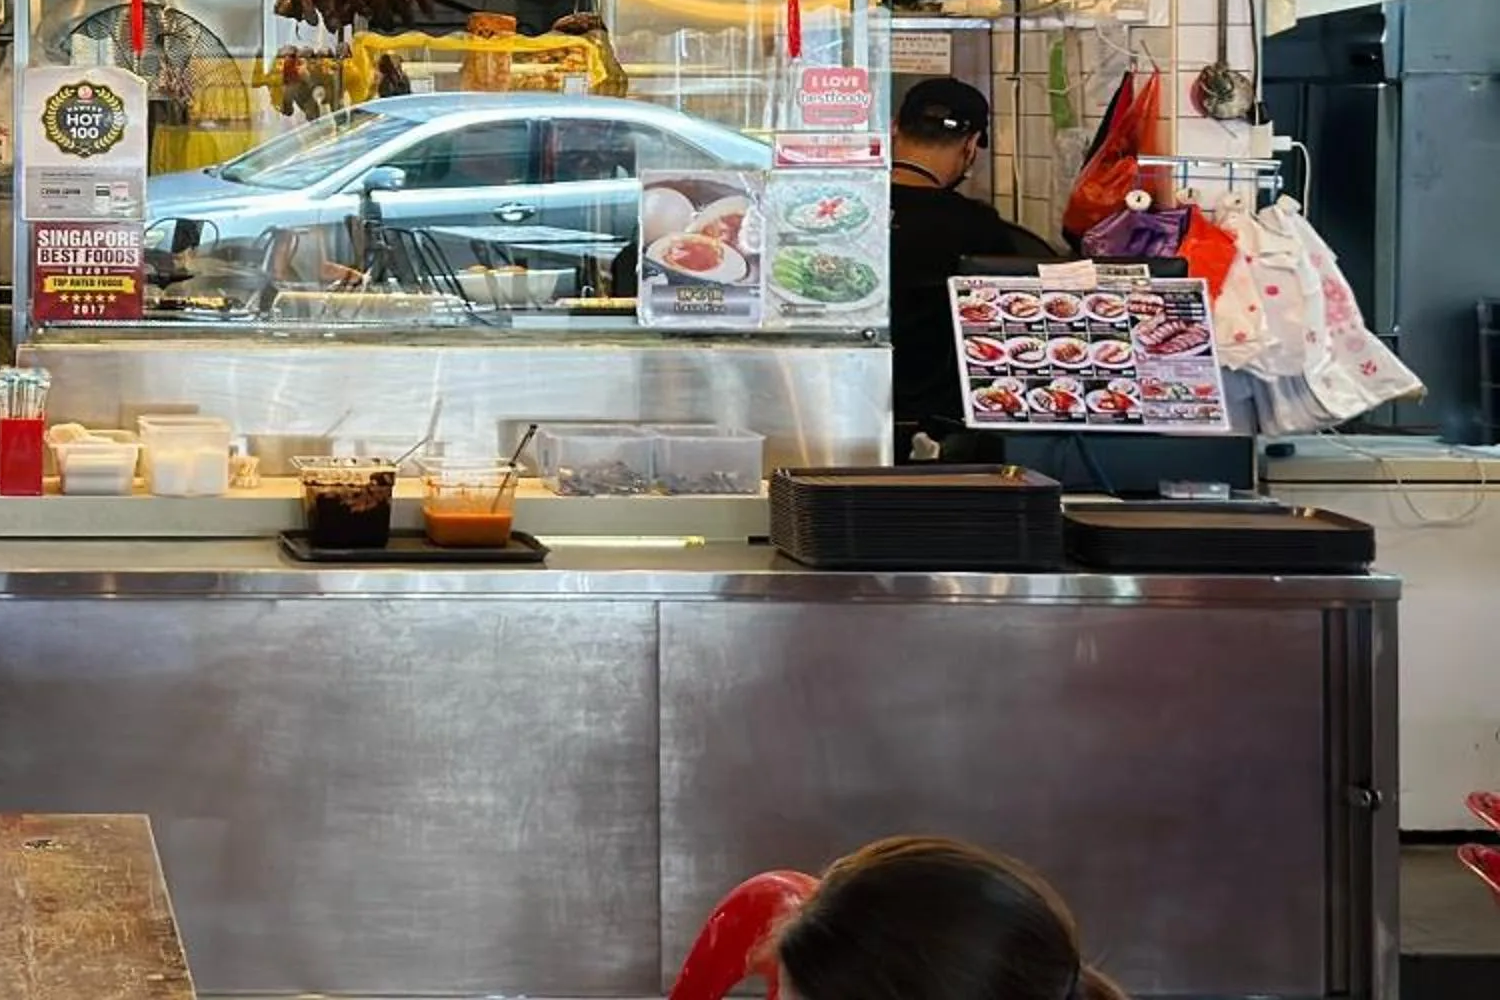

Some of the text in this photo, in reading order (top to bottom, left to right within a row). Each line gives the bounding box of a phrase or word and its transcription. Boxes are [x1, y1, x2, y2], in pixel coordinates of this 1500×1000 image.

[821, 76, 860, 87] LOVE
[66, 113, 103, 127] HOT
[69, 127, 100, 139] 100
[38, 229, 140, 247] SINGAPORE
[40, 249, 136, 264] BEST FOODS
[72, 303, 105, 315] 2017
